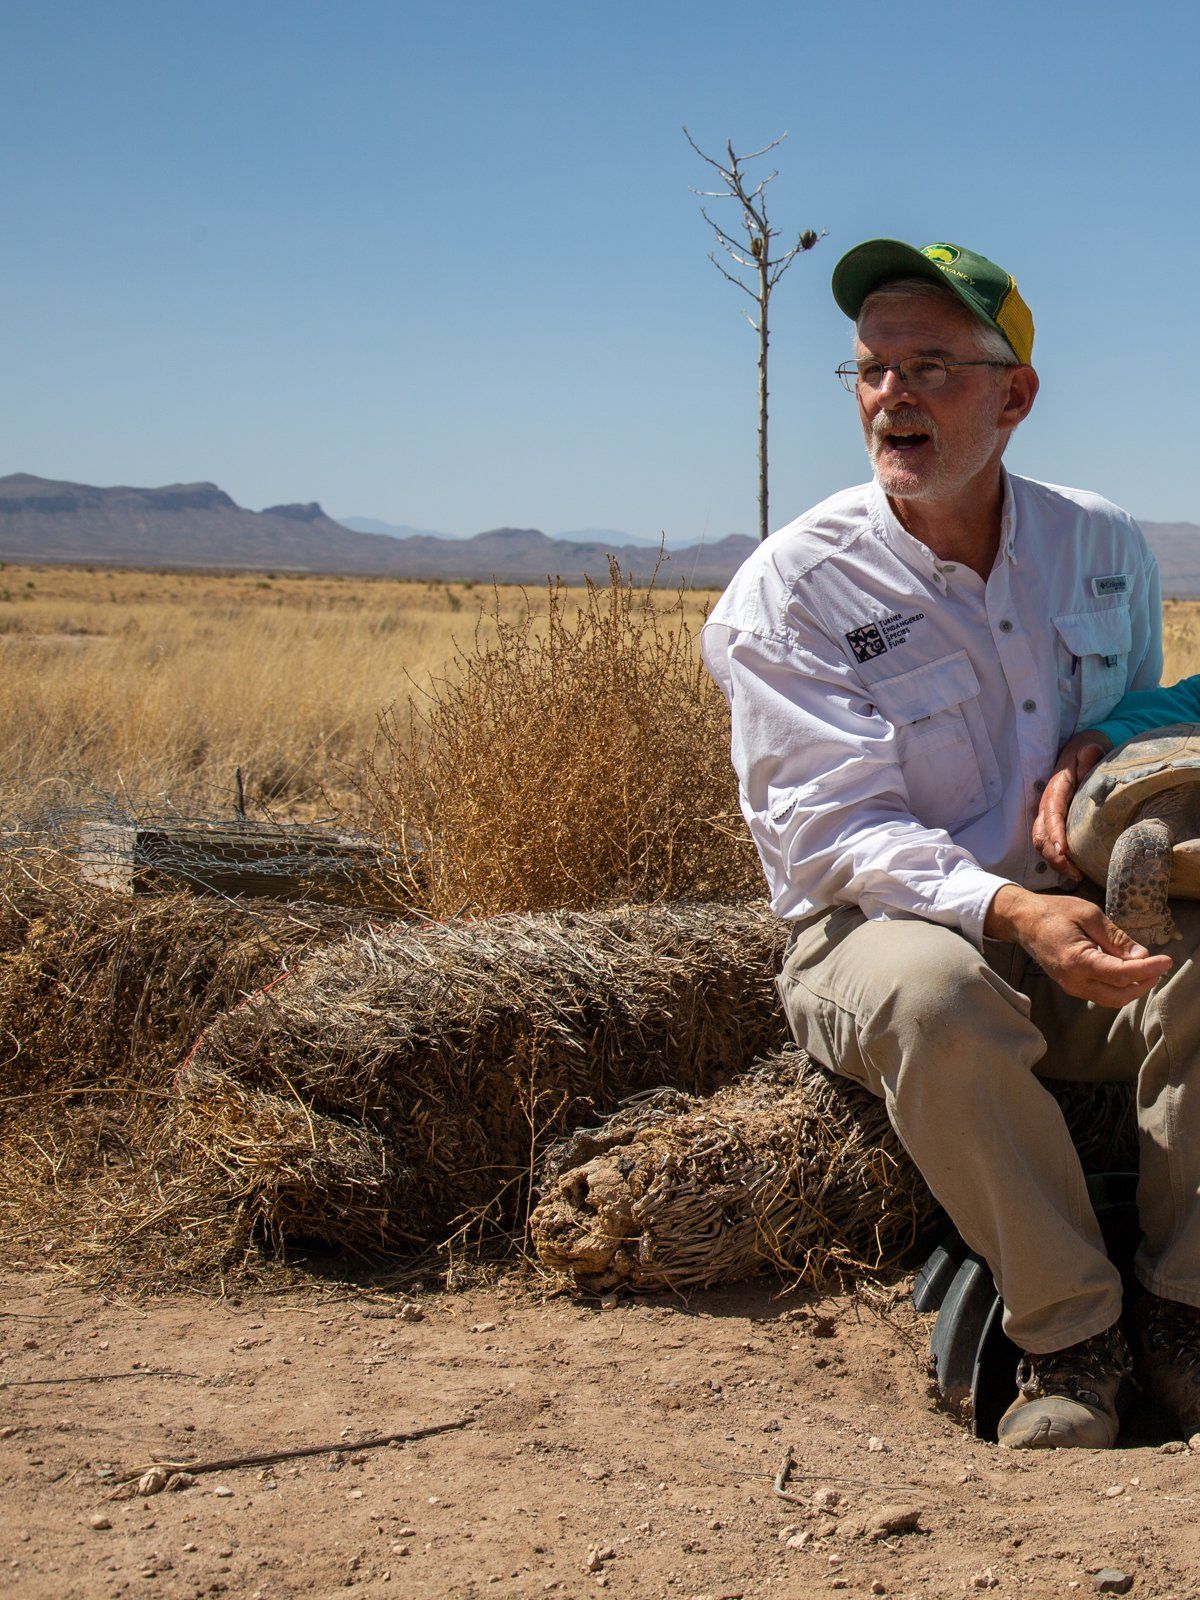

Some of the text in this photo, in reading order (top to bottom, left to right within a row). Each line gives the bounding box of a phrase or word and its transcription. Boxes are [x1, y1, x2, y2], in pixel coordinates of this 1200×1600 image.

[878, 613, 903, 628] TURNER
[882, 613, 925, 635] ENDANGERED
[885, 627, 911, 642] SPECIES
[889, 637, 906, 649] FUND
